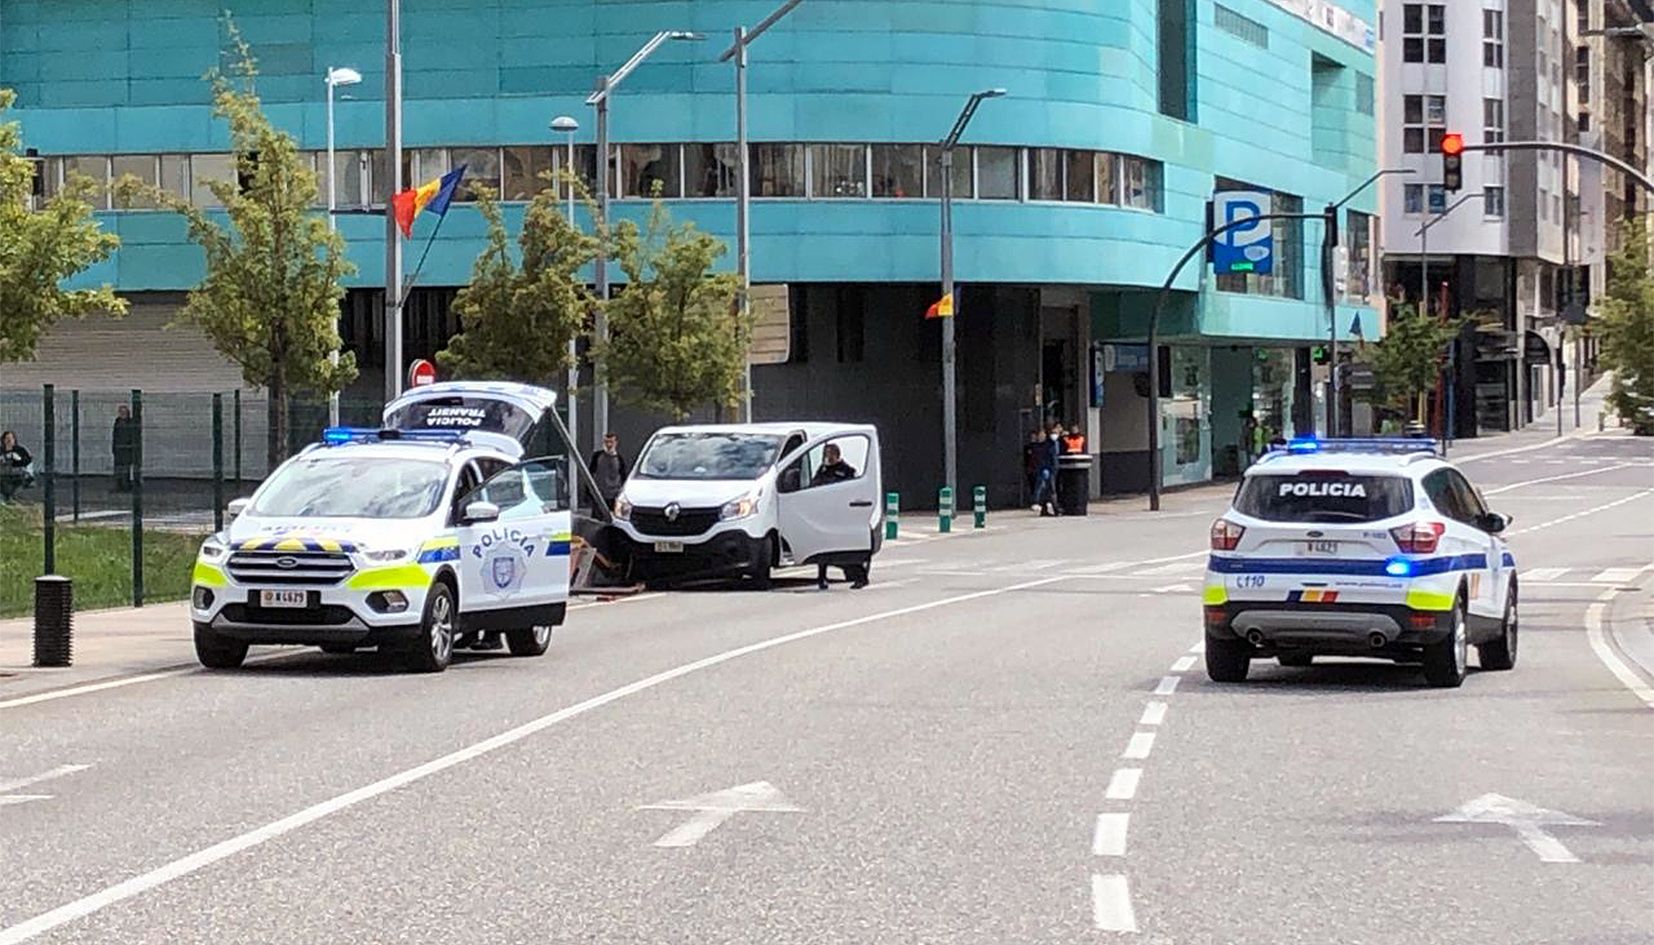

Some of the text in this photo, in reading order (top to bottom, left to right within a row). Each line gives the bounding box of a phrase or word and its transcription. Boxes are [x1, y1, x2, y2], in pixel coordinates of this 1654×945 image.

[1226, 201, 1259, 244] P
[428, 408, 486, 417] TRANSIT
[426, 417, 482, 426] POLICIA
[1279, 483, 1366, 497] POLICIA
